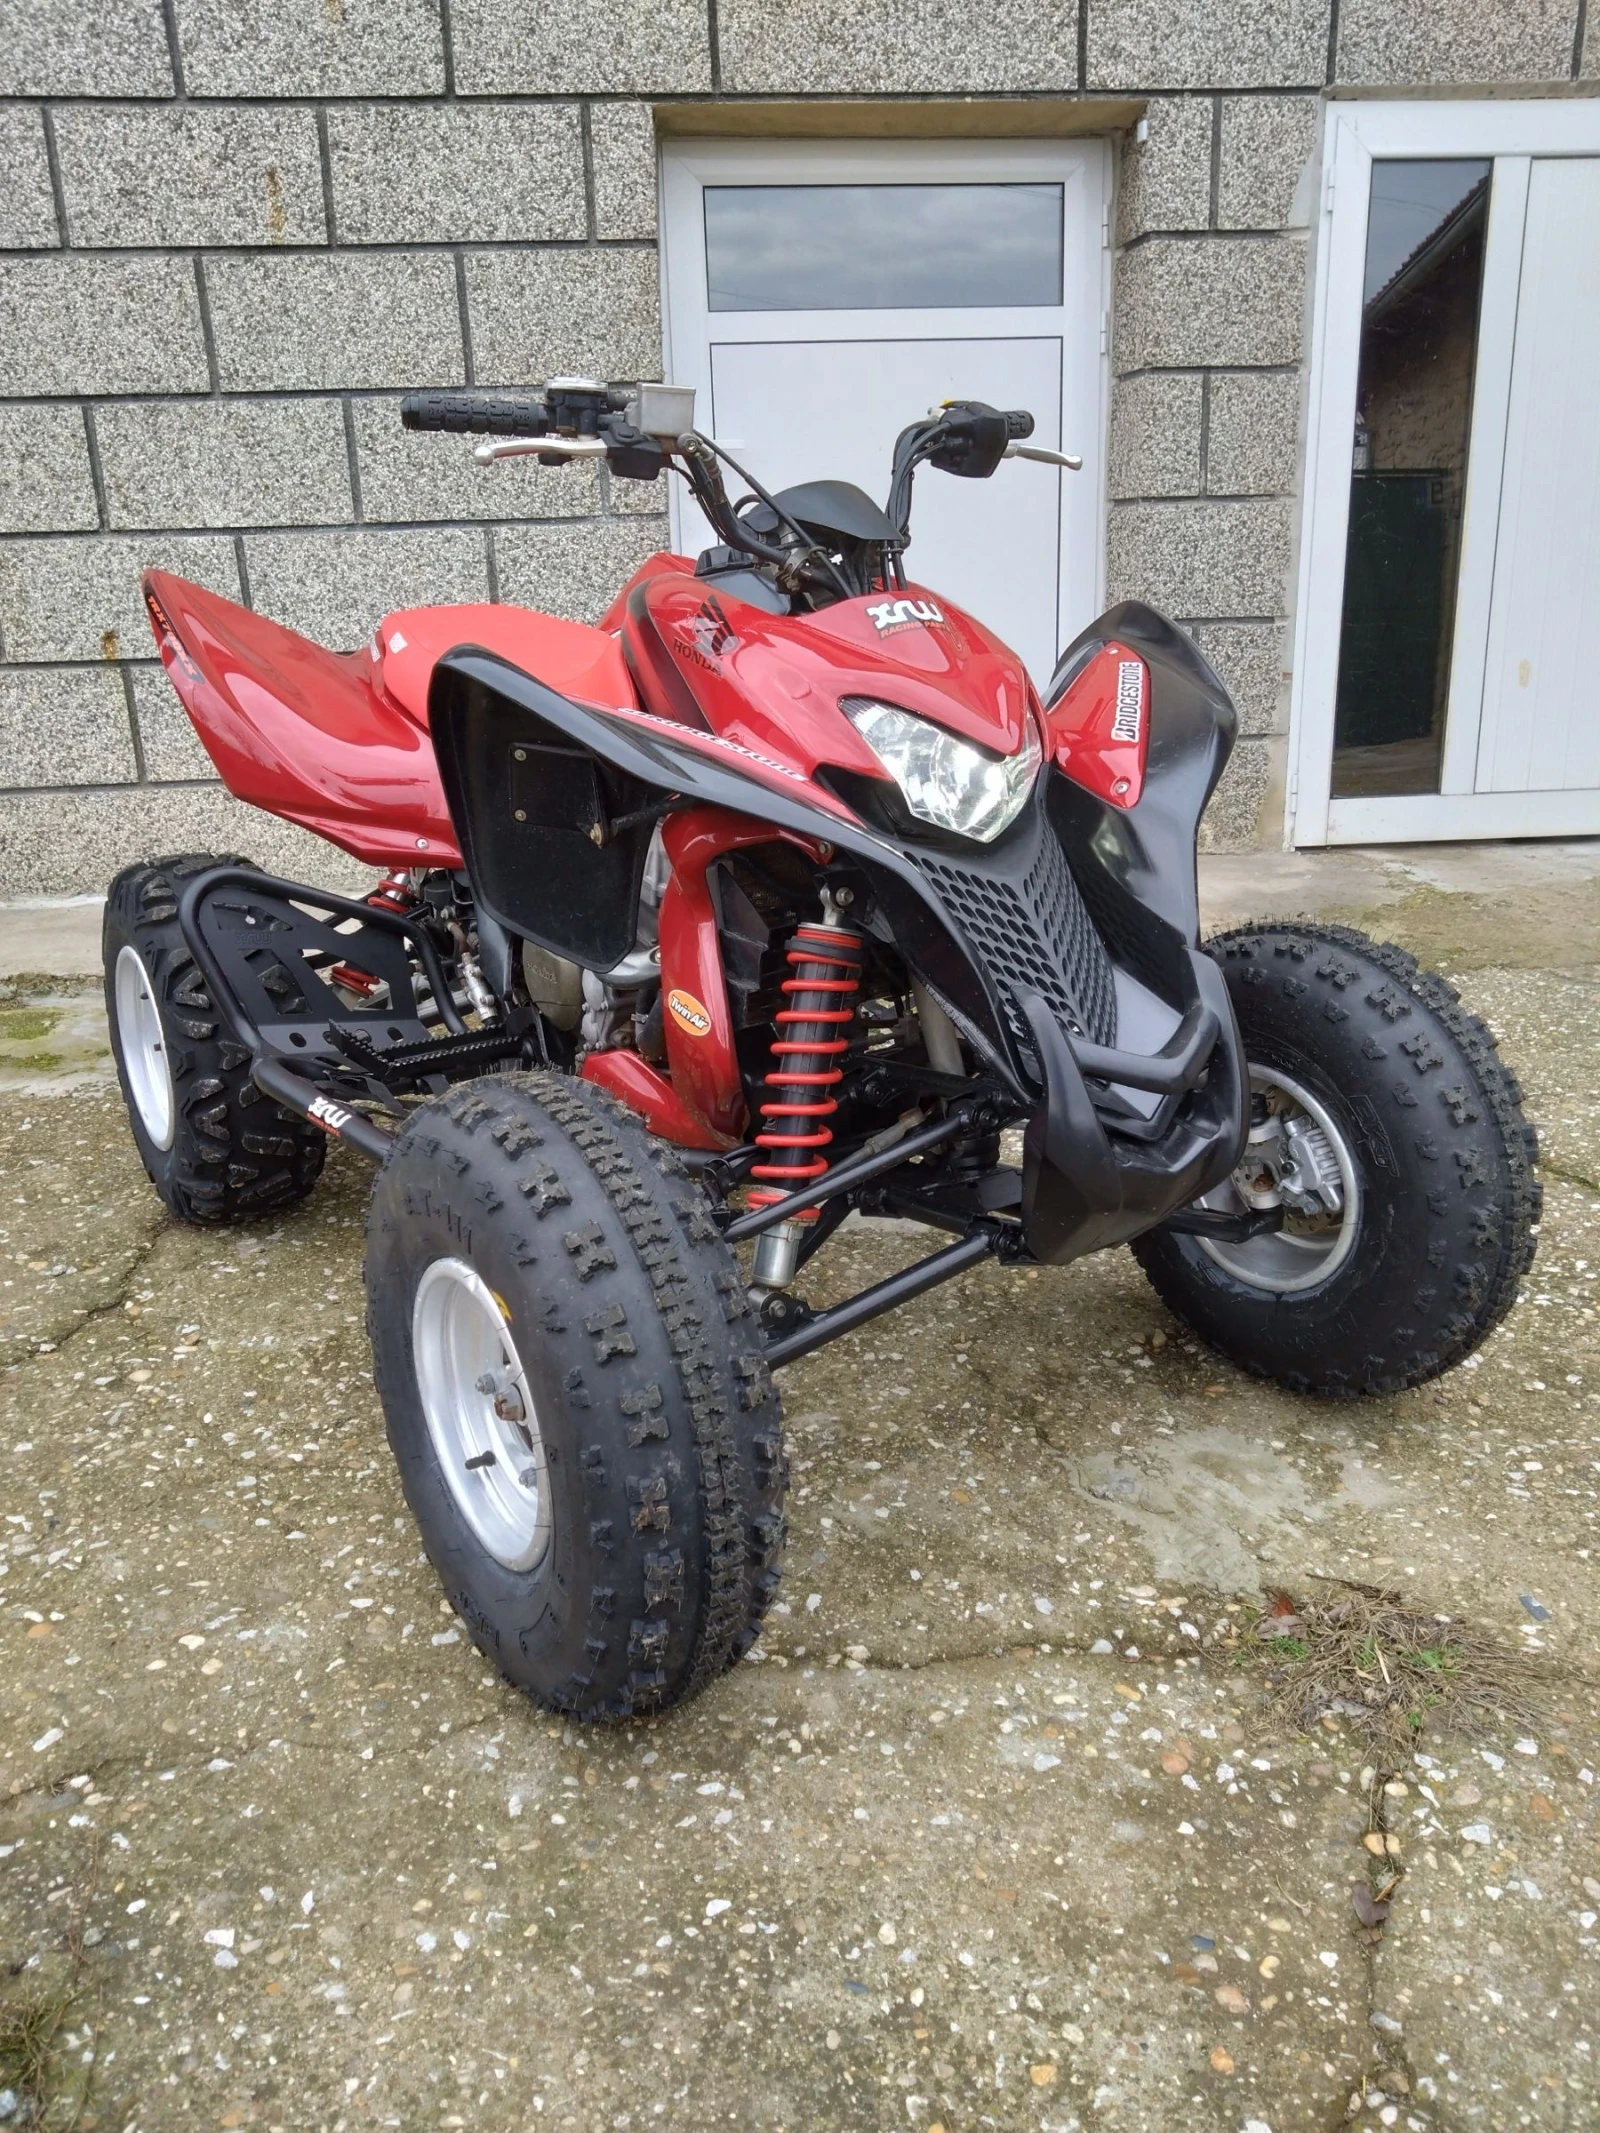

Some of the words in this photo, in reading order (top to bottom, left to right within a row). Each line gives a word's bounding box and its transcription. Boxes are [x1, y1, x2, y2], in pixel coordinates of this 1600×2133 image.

[881, 622, 922, 638] RACING
[673, 638, 721, 676] HONDA
[1115, 663, 1141, 740] BRIDGESTONE
[671, 995, 692, 1019] Twin
[690, 1013, 708, 1029] Air
